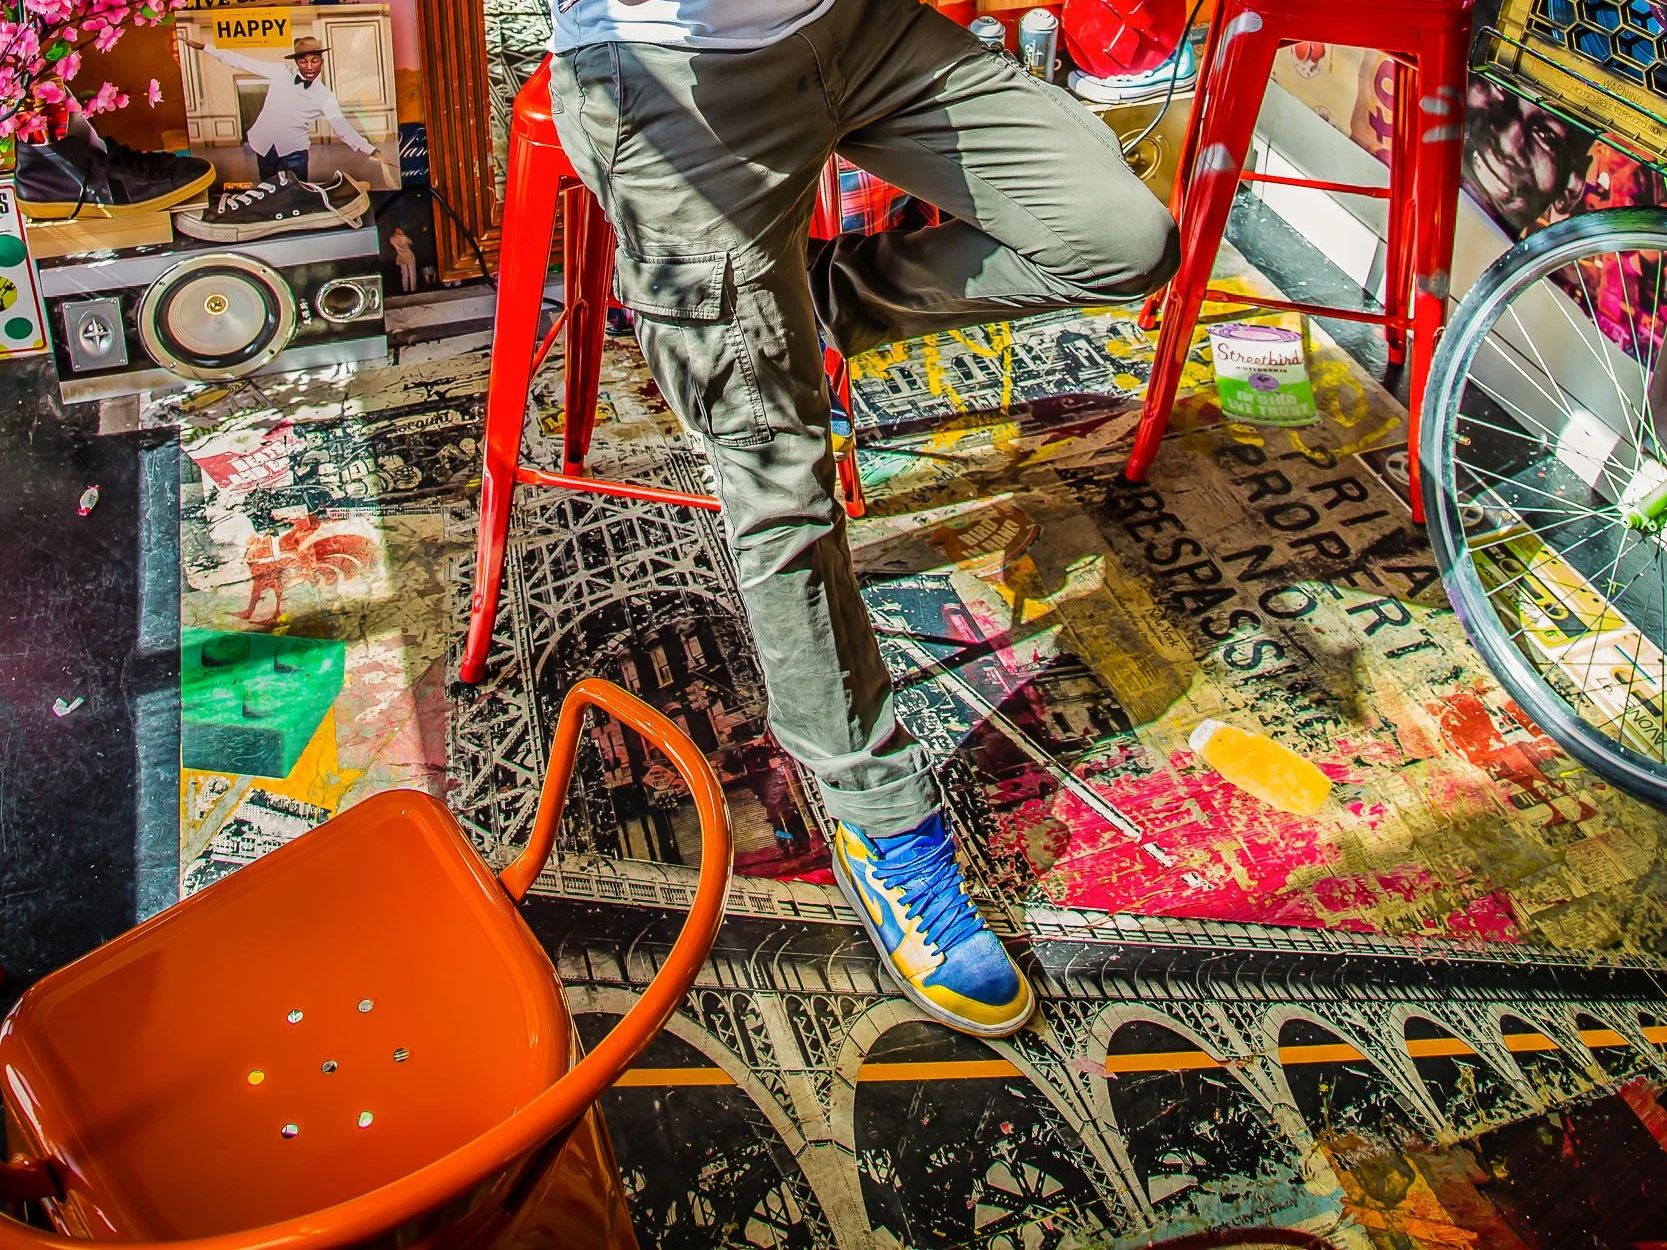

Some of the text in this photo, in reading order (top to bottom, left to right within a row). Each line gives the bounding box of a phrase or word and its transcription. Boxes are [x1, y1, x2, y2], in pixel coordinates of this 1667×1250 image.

[216, 18, 287, 39] HAPPY
[1603, 77, 1644, 105] WARNING
[1216, 342, 1304, 366] Streetbird
[957, 517, 999, 547] BIRD
[1221, 543, 1319, 621] NO
